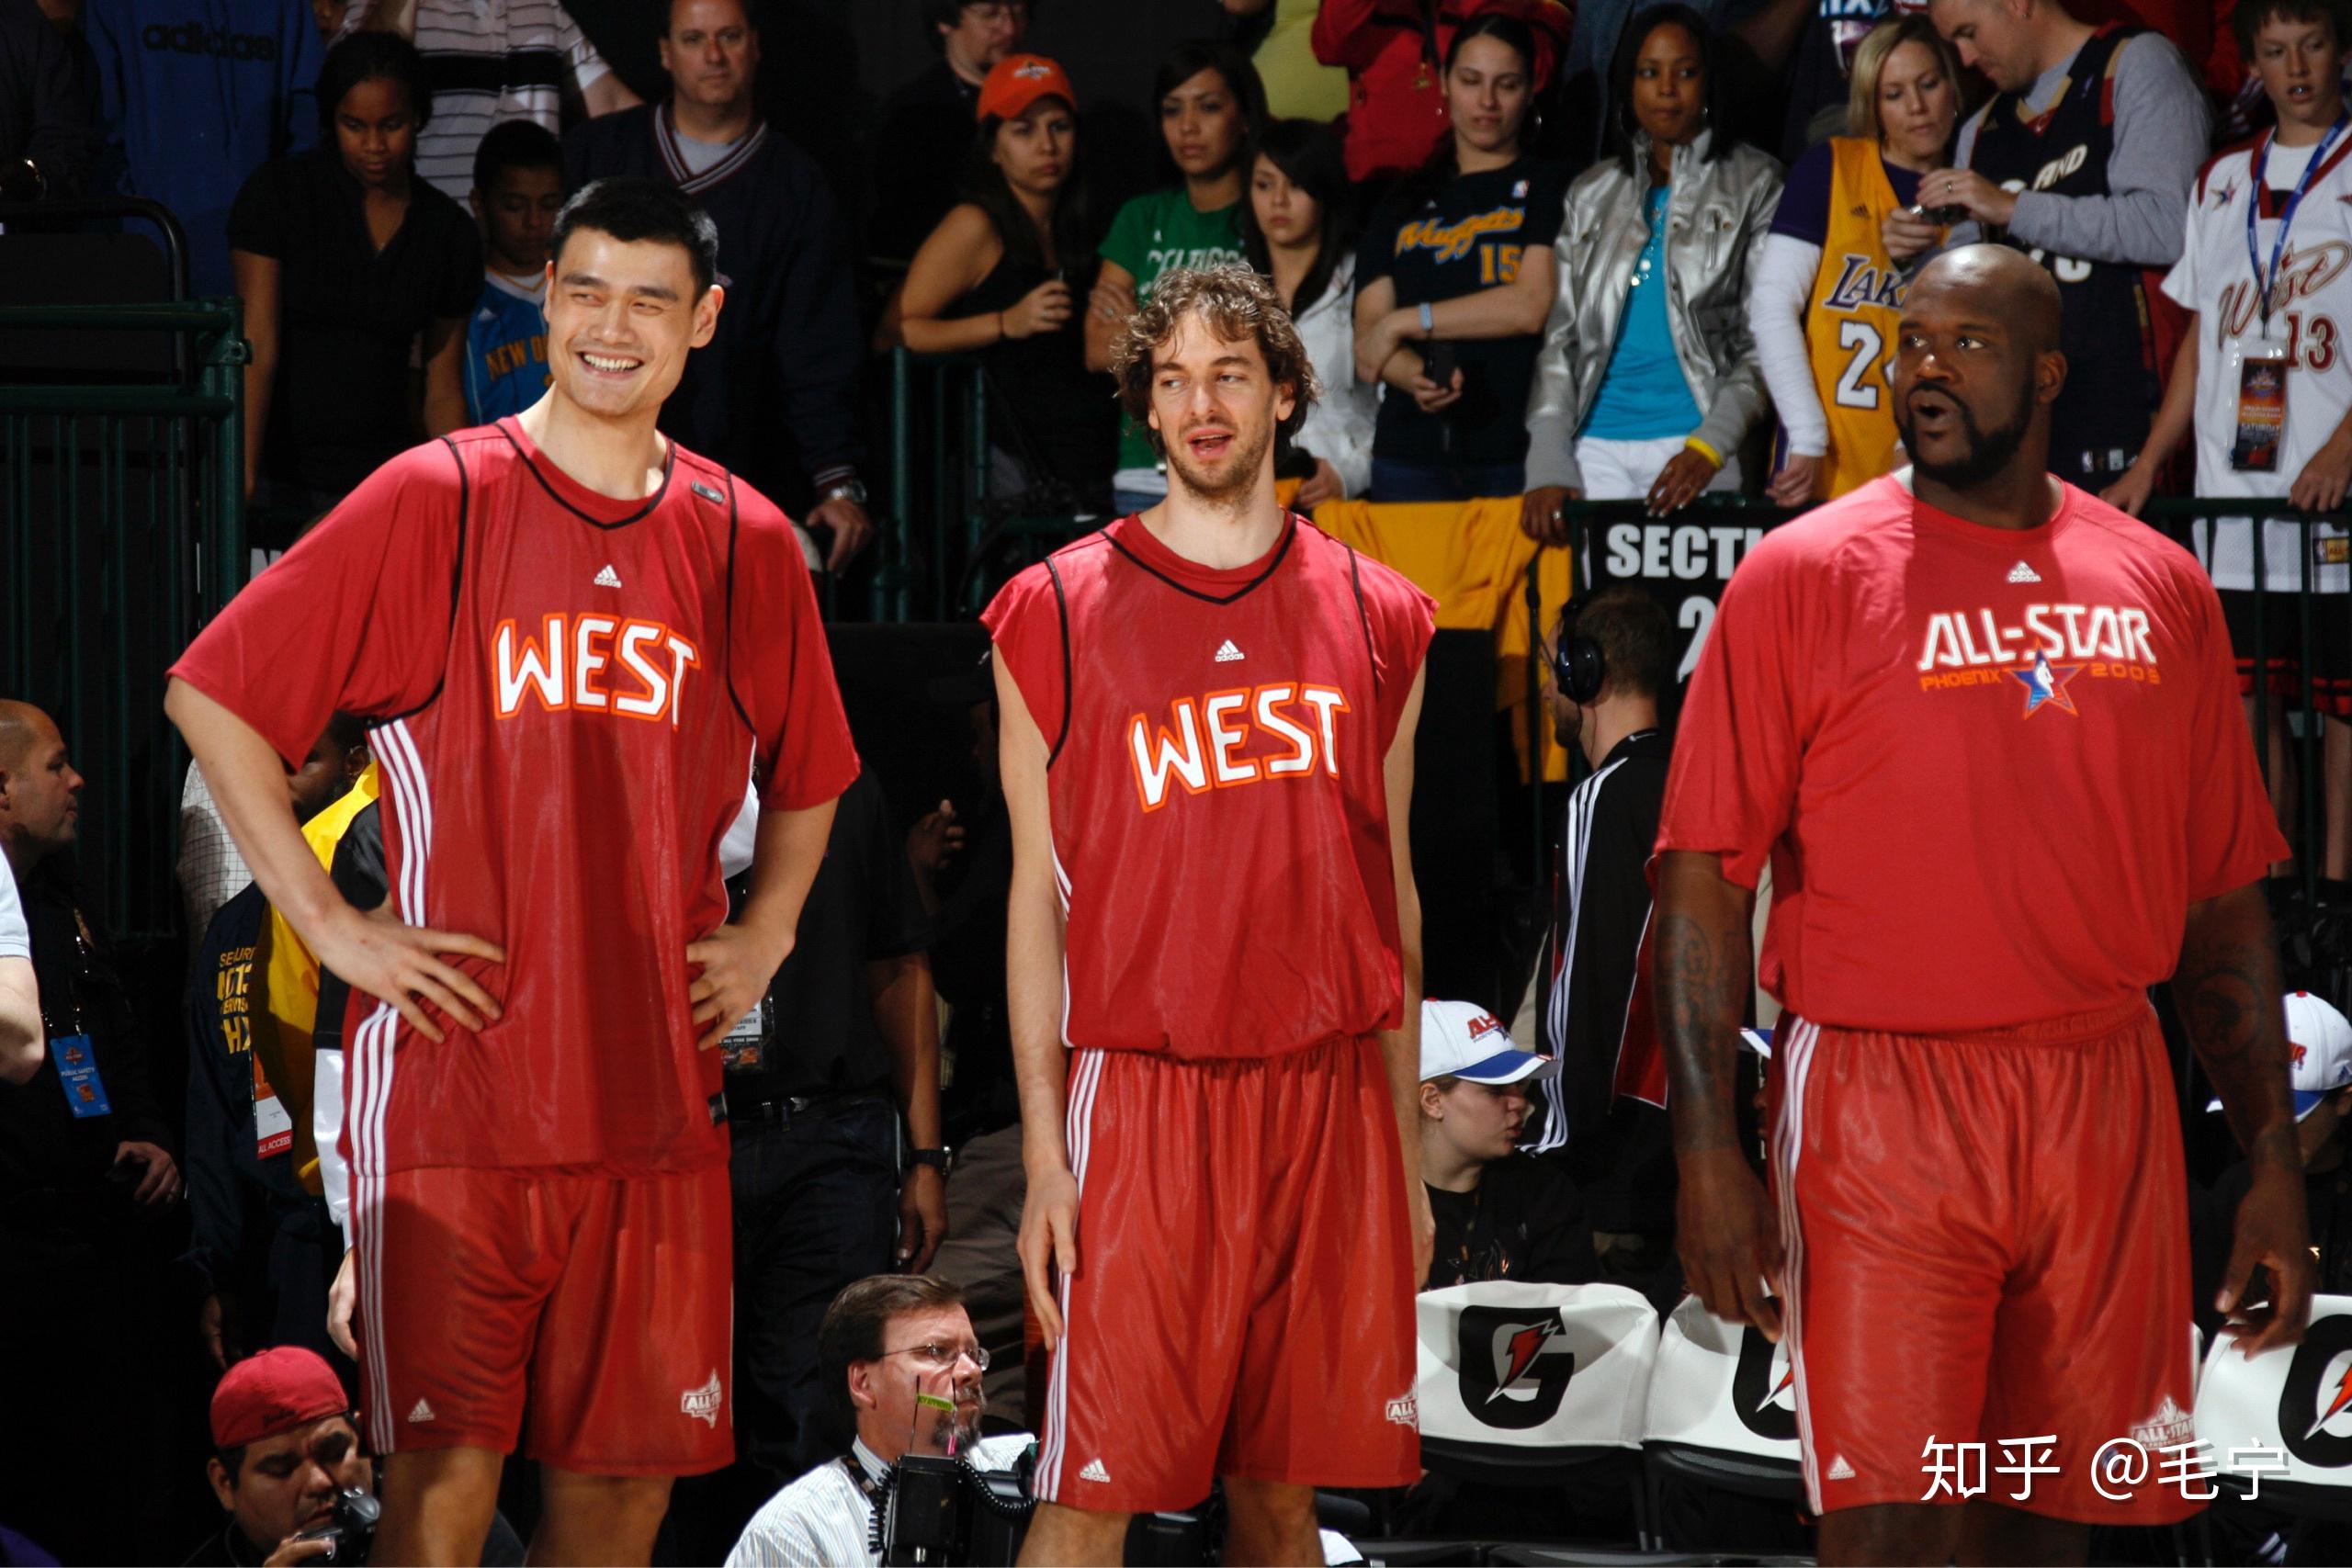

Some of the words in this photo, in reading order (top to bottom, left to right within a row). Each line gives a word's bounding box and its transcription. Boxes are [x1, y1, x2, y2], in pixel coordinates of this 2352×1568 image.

[1480, 243, 1522, 285] 15
[484, 338, 528, 383] NEW
[1836, 320, 1897, 411] 2
[2285, 310, 2338, 373] 13
[1917, 603, 2157, 671] ALL-STAR
[492, 612, 701, 732] WEST
[1919, 667, 2004, 692] PHOENIX
[1127, 682, 1351, 813] WEST
[267, 1135, 291, 1150] ACCESS
